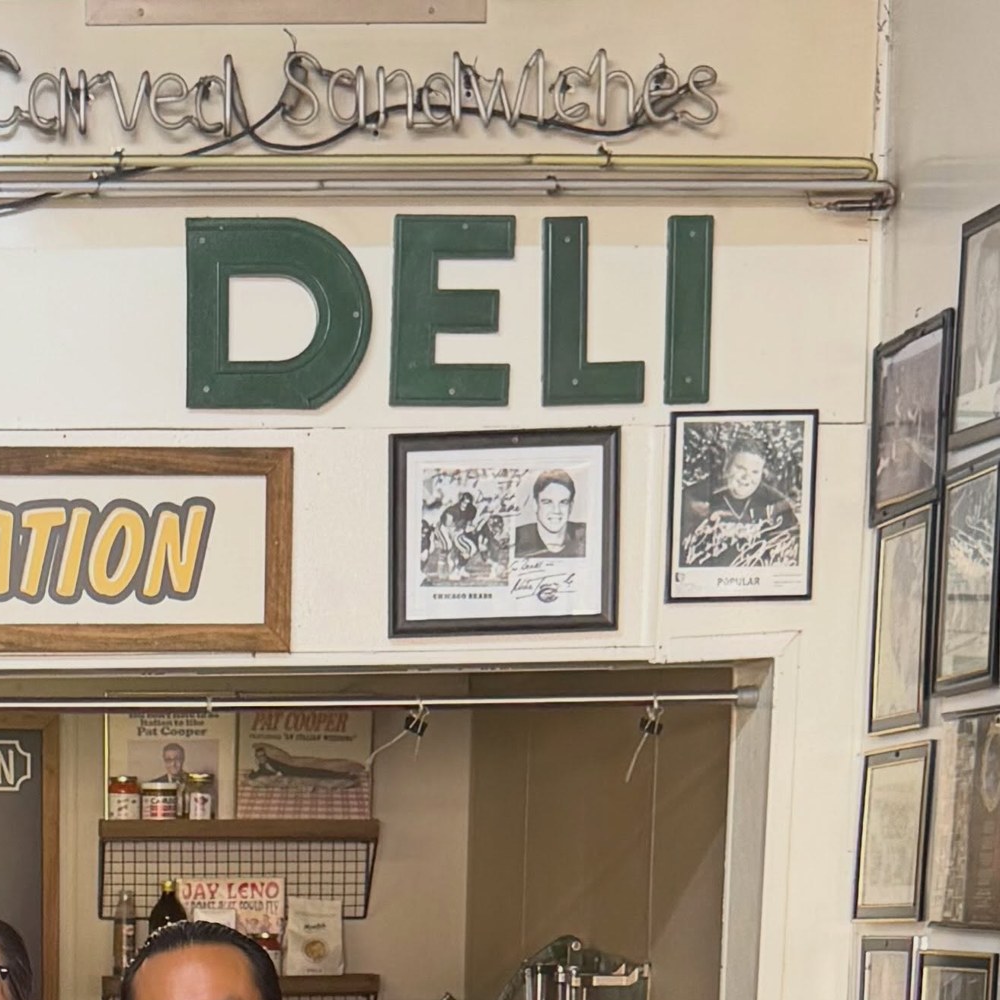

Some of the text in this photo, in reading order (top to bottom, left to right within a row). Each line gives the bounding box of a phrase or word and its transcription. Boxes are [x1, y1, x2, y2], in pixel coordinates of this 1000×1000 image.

[186, 214, 715, 410] DELI
[251, 711, 349, 733] PAT COOPER
[137, 727, 207, 738] Pat Cooper
[182, 881, 280, 900] JAY LENO
